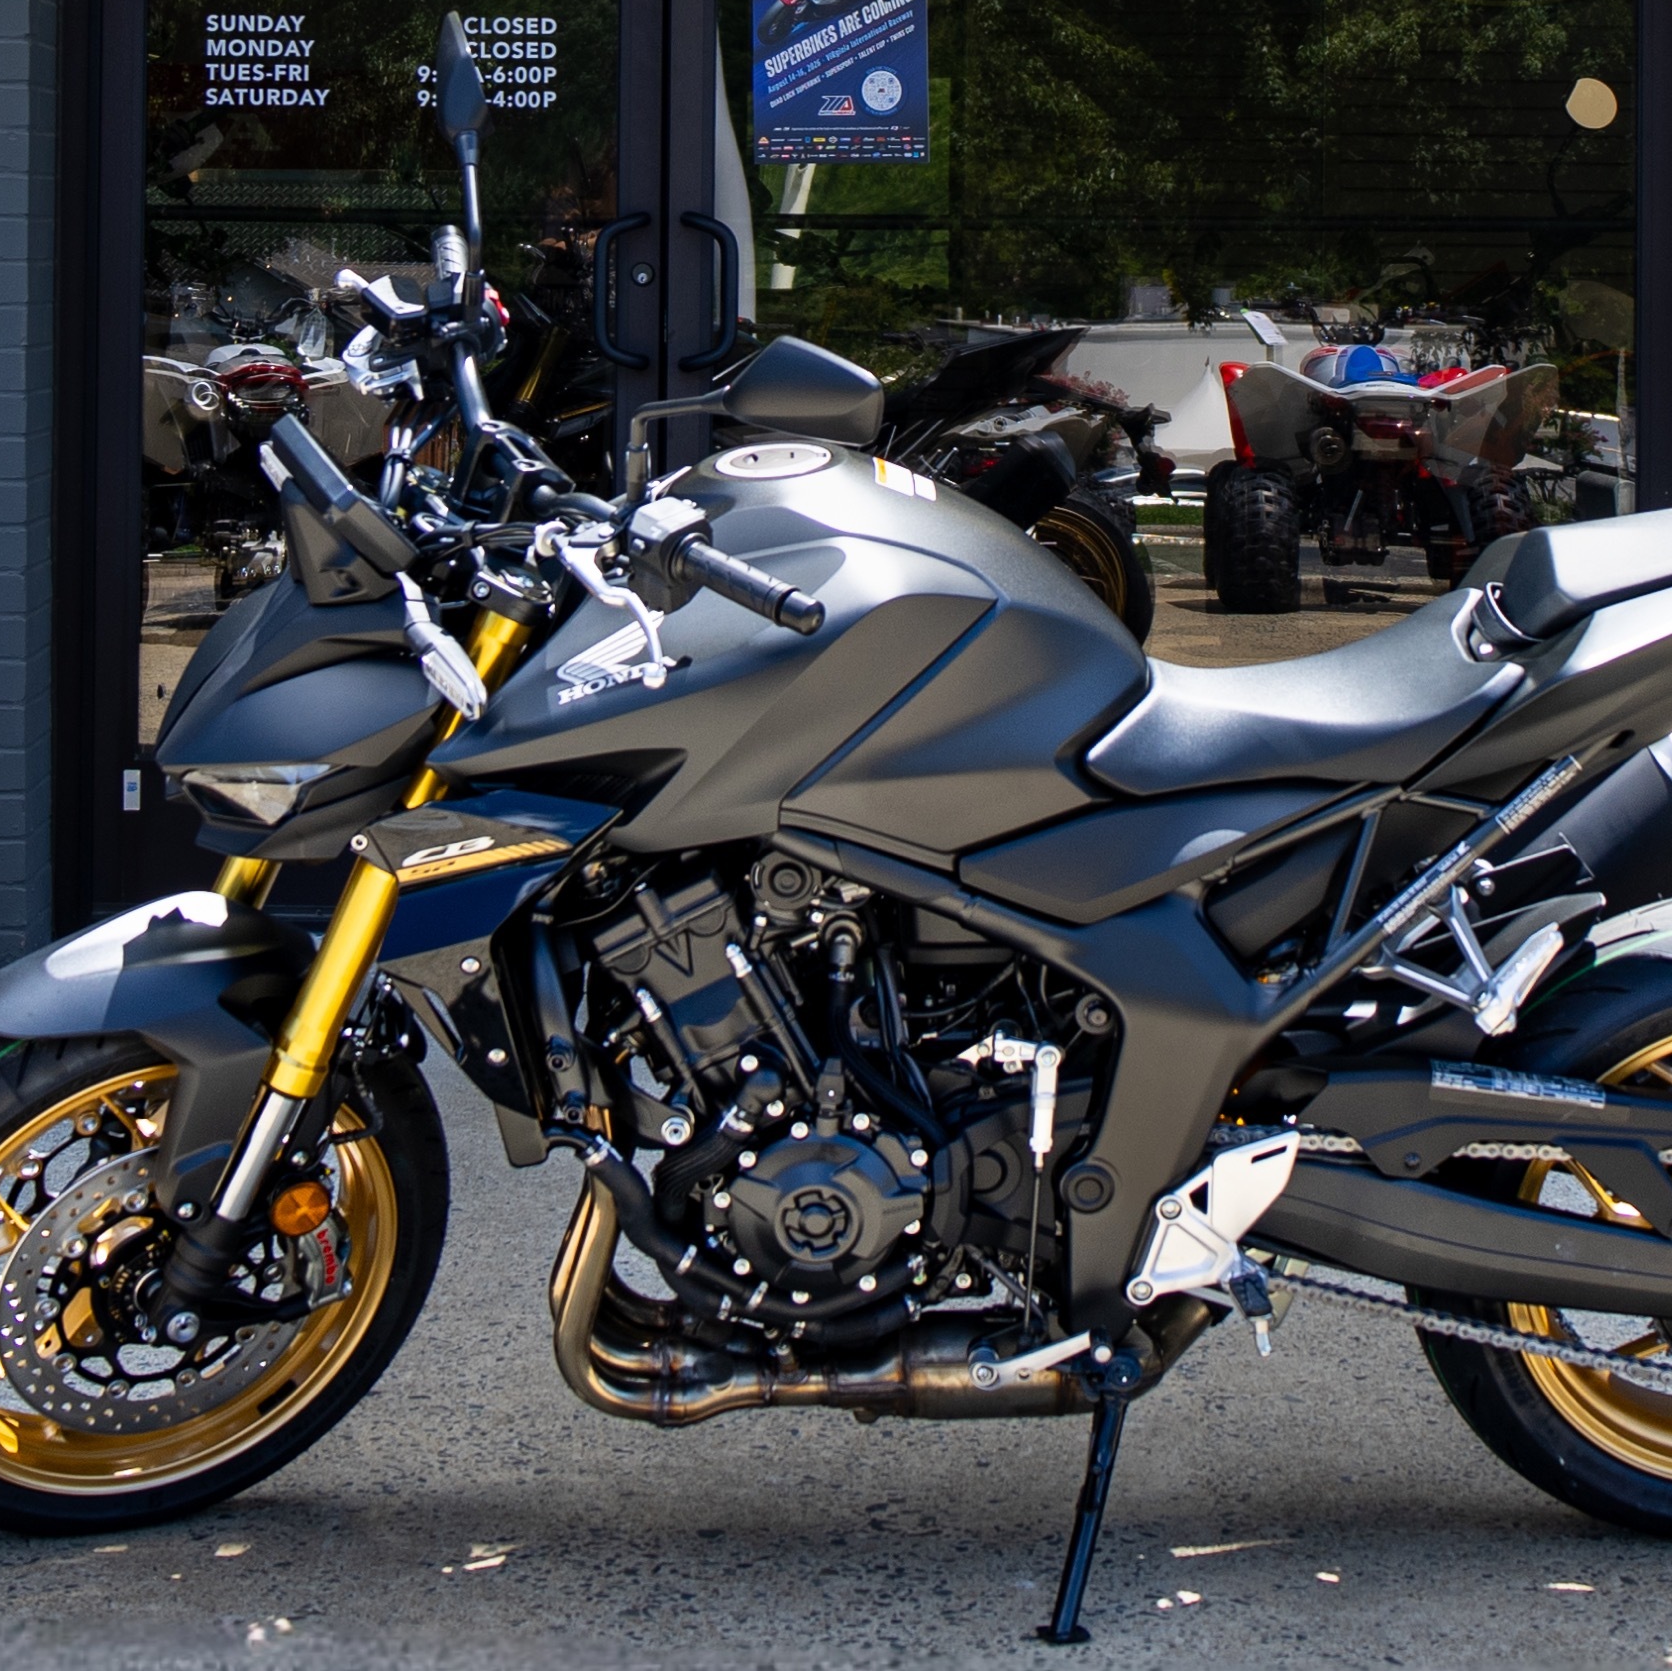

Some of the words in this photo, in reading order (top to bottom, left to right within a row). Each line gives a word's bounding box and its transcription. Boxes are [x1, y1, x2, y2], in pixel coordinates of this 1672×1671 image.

[206, 14, 306, 33] SUNDAY
[463, 16, 558, 35] CLOSED
[205, 38, 315, 57] MONDAY
[465, 41, 558, 59] CLOSED
[764, 24, 838, 78] SUPERBIKES
[838, 11, 863, 38] ARE
[767, 78, 788, 94] August
[849, 22, 888, 49] International
[888, 9, 913, 28] Raceway
[858, 45, 877, 60] TALENT
[876, 40, 887, 51] CUP
[905, 24, 916, 36] CUP
[205, 63, 310, 82] TUES-FRI
[417, 65, 558, 84] 9:-6:00P
[205, 87, 331, 106] SATURDAY
[417, 90, 558, 108] 9:-4:00P
[558, 657, 677, 705] HON
[402, 836, 495, 868] CB
[316, 1228, 339, 1285] brembo
